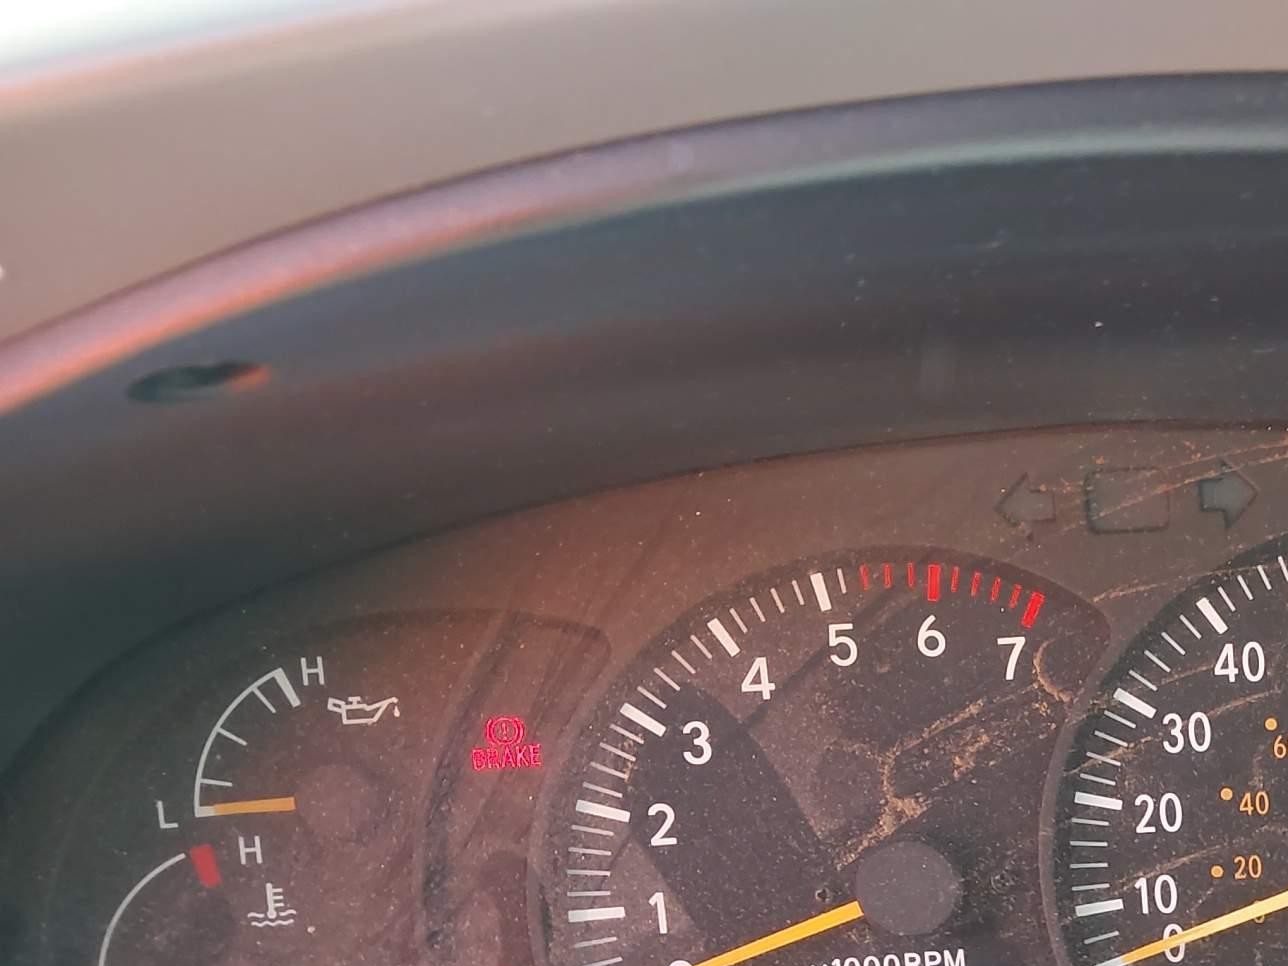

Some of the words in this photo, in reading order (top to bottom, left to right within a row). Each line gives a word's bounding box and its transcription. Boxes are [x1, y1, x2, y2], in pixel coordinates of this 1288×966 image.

[828, 623, 858, 666] 5
[916, 614, 946, 657] 6
[300, 656, 325, 686] H
[741, 657, 776, 700] 4
[996, 636, 1026, 680] 7
[1214, 641, 1266, 683] 40
[682, 721, 713, 765] 3
[1162, 711, 1212, 754] 30
[472, 744, 542, 771] BRAKE
[157, 801, 179, 829] L
[1134, 792, 1183, 833] 20
[1239, 791, 1269, 815] 40
[647, 804, 677, 846] 2
[239, 836, 263, 865] H
[1234, 855, 1263, 879] 20
[648, 892, 668, 935] 1
[1134, 874, 1178, 915] 10
[1164, 923, 1186, 962] 0
